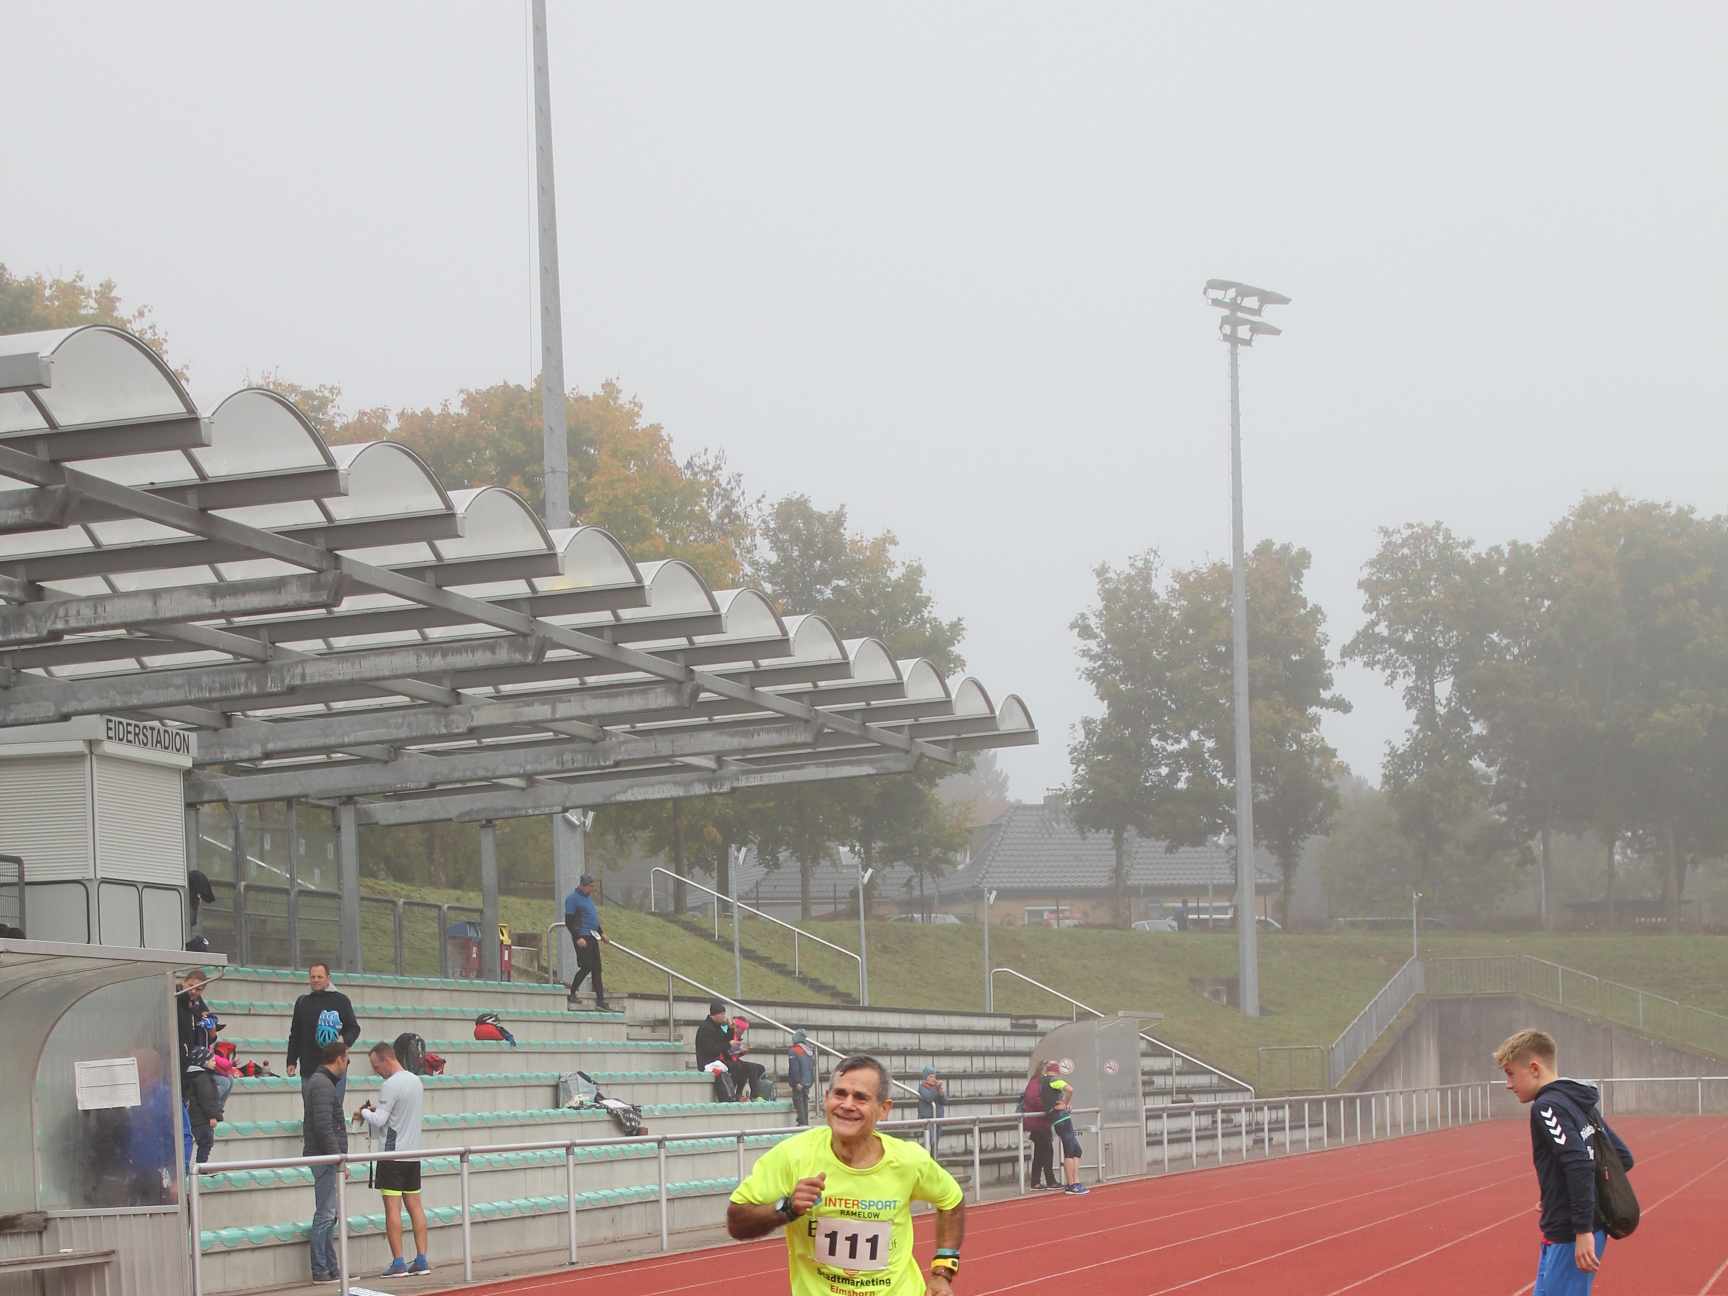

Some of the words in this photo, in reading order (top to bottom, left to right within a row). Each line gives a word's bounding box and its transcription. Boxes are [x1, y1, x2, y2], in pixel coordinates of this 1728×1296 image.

[106, 719, 190, 755] EIDERSTADION
[824, 1196, 898, 1211] INTERSPORT
[840, 1210, 881, 1220] RAMELOW
[824, 1230, 880, 1261] 111
